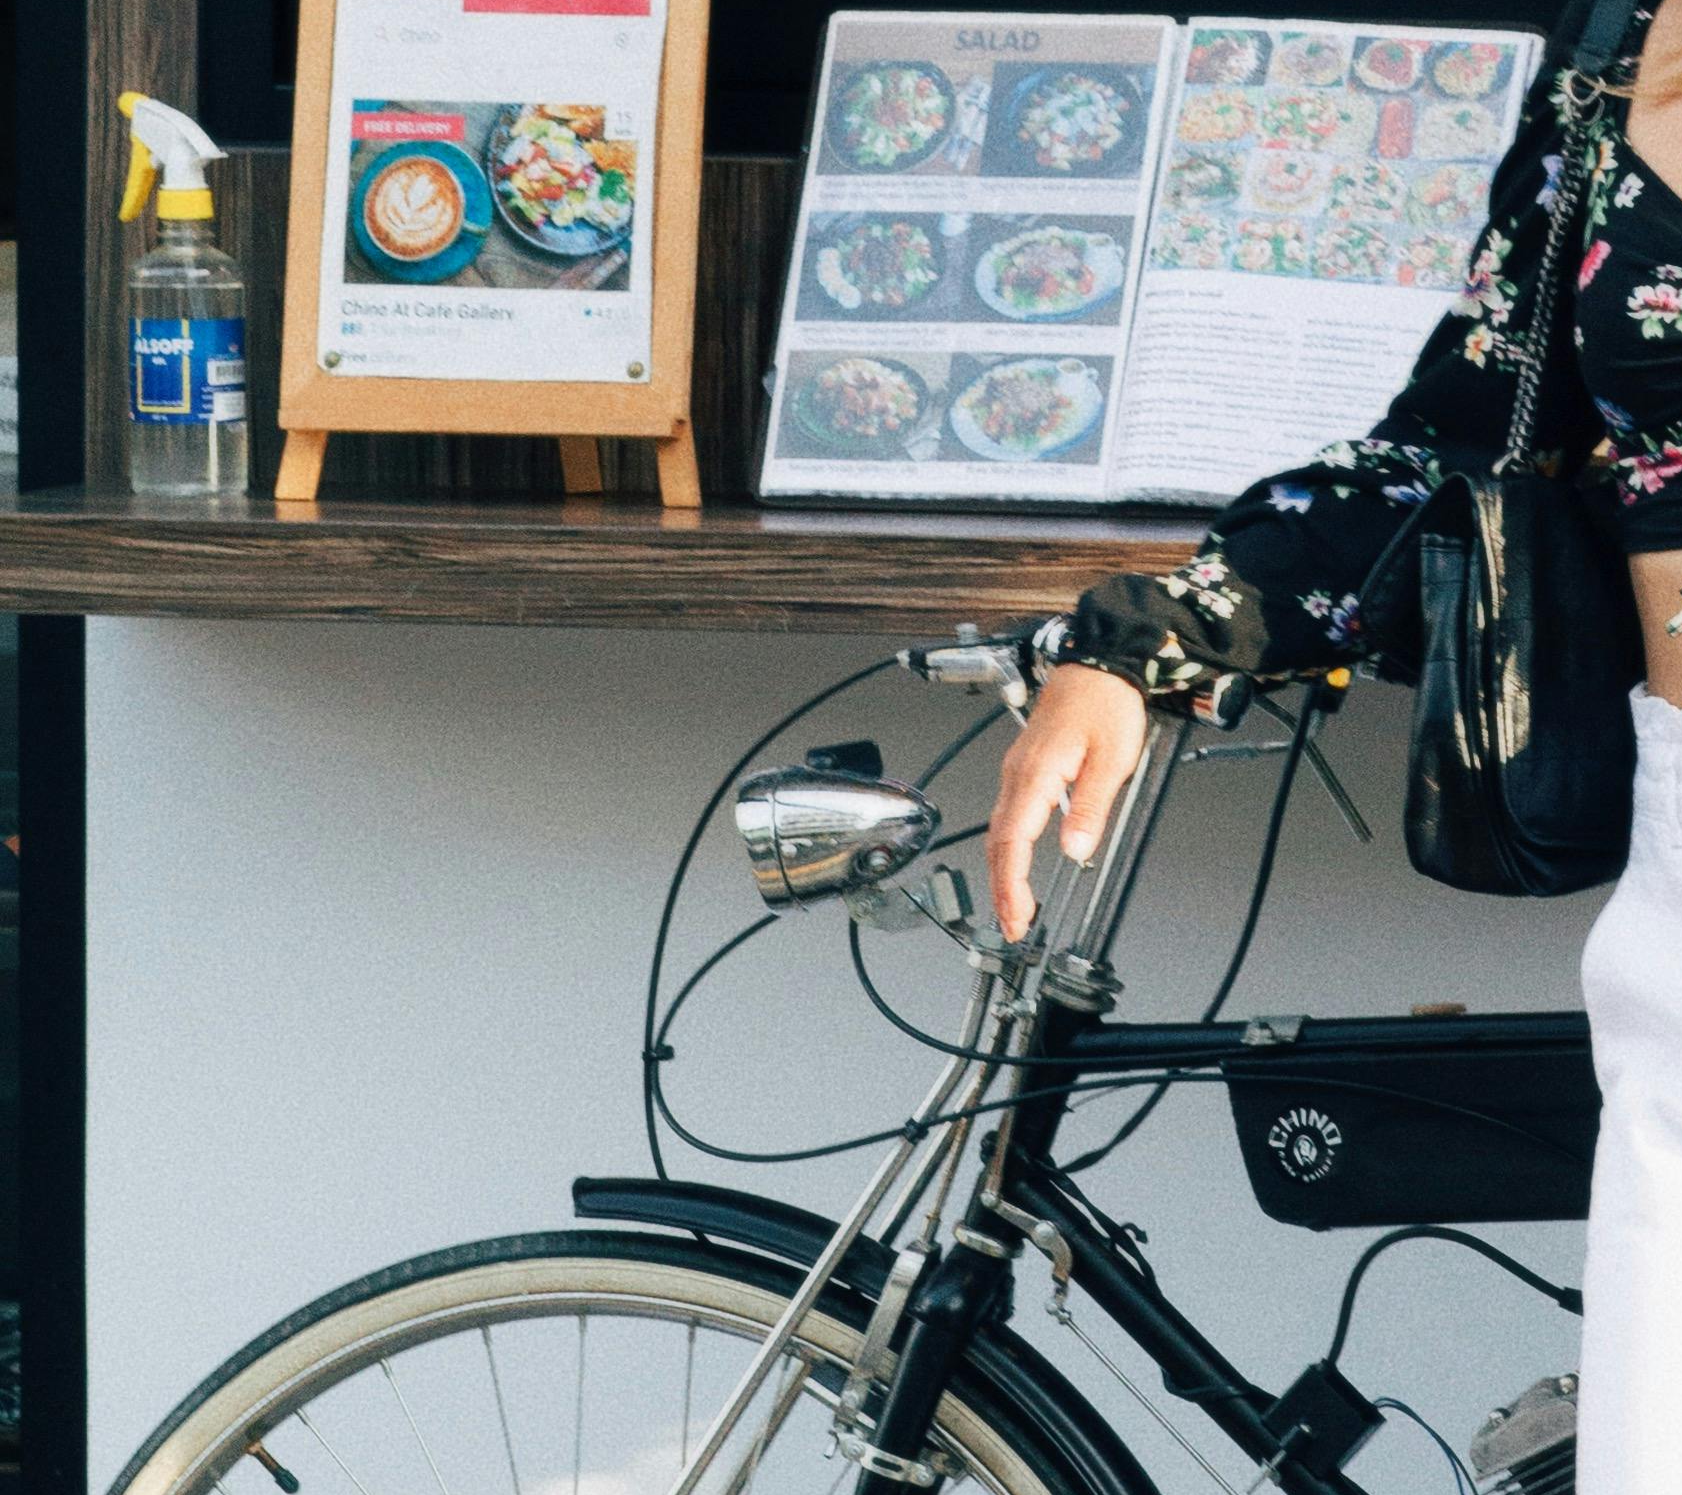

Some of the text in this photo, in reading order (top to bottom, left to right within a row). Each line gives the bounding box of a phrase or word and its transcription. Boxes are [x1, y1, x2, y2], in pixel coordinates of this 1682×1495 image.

[954, 29, 1041, 51] SALAD
[414, 303, 453, 320] Cafe
[458, 304, 514, 322] Gallery
[1268, 1107, 1343, 1149] CHINO
